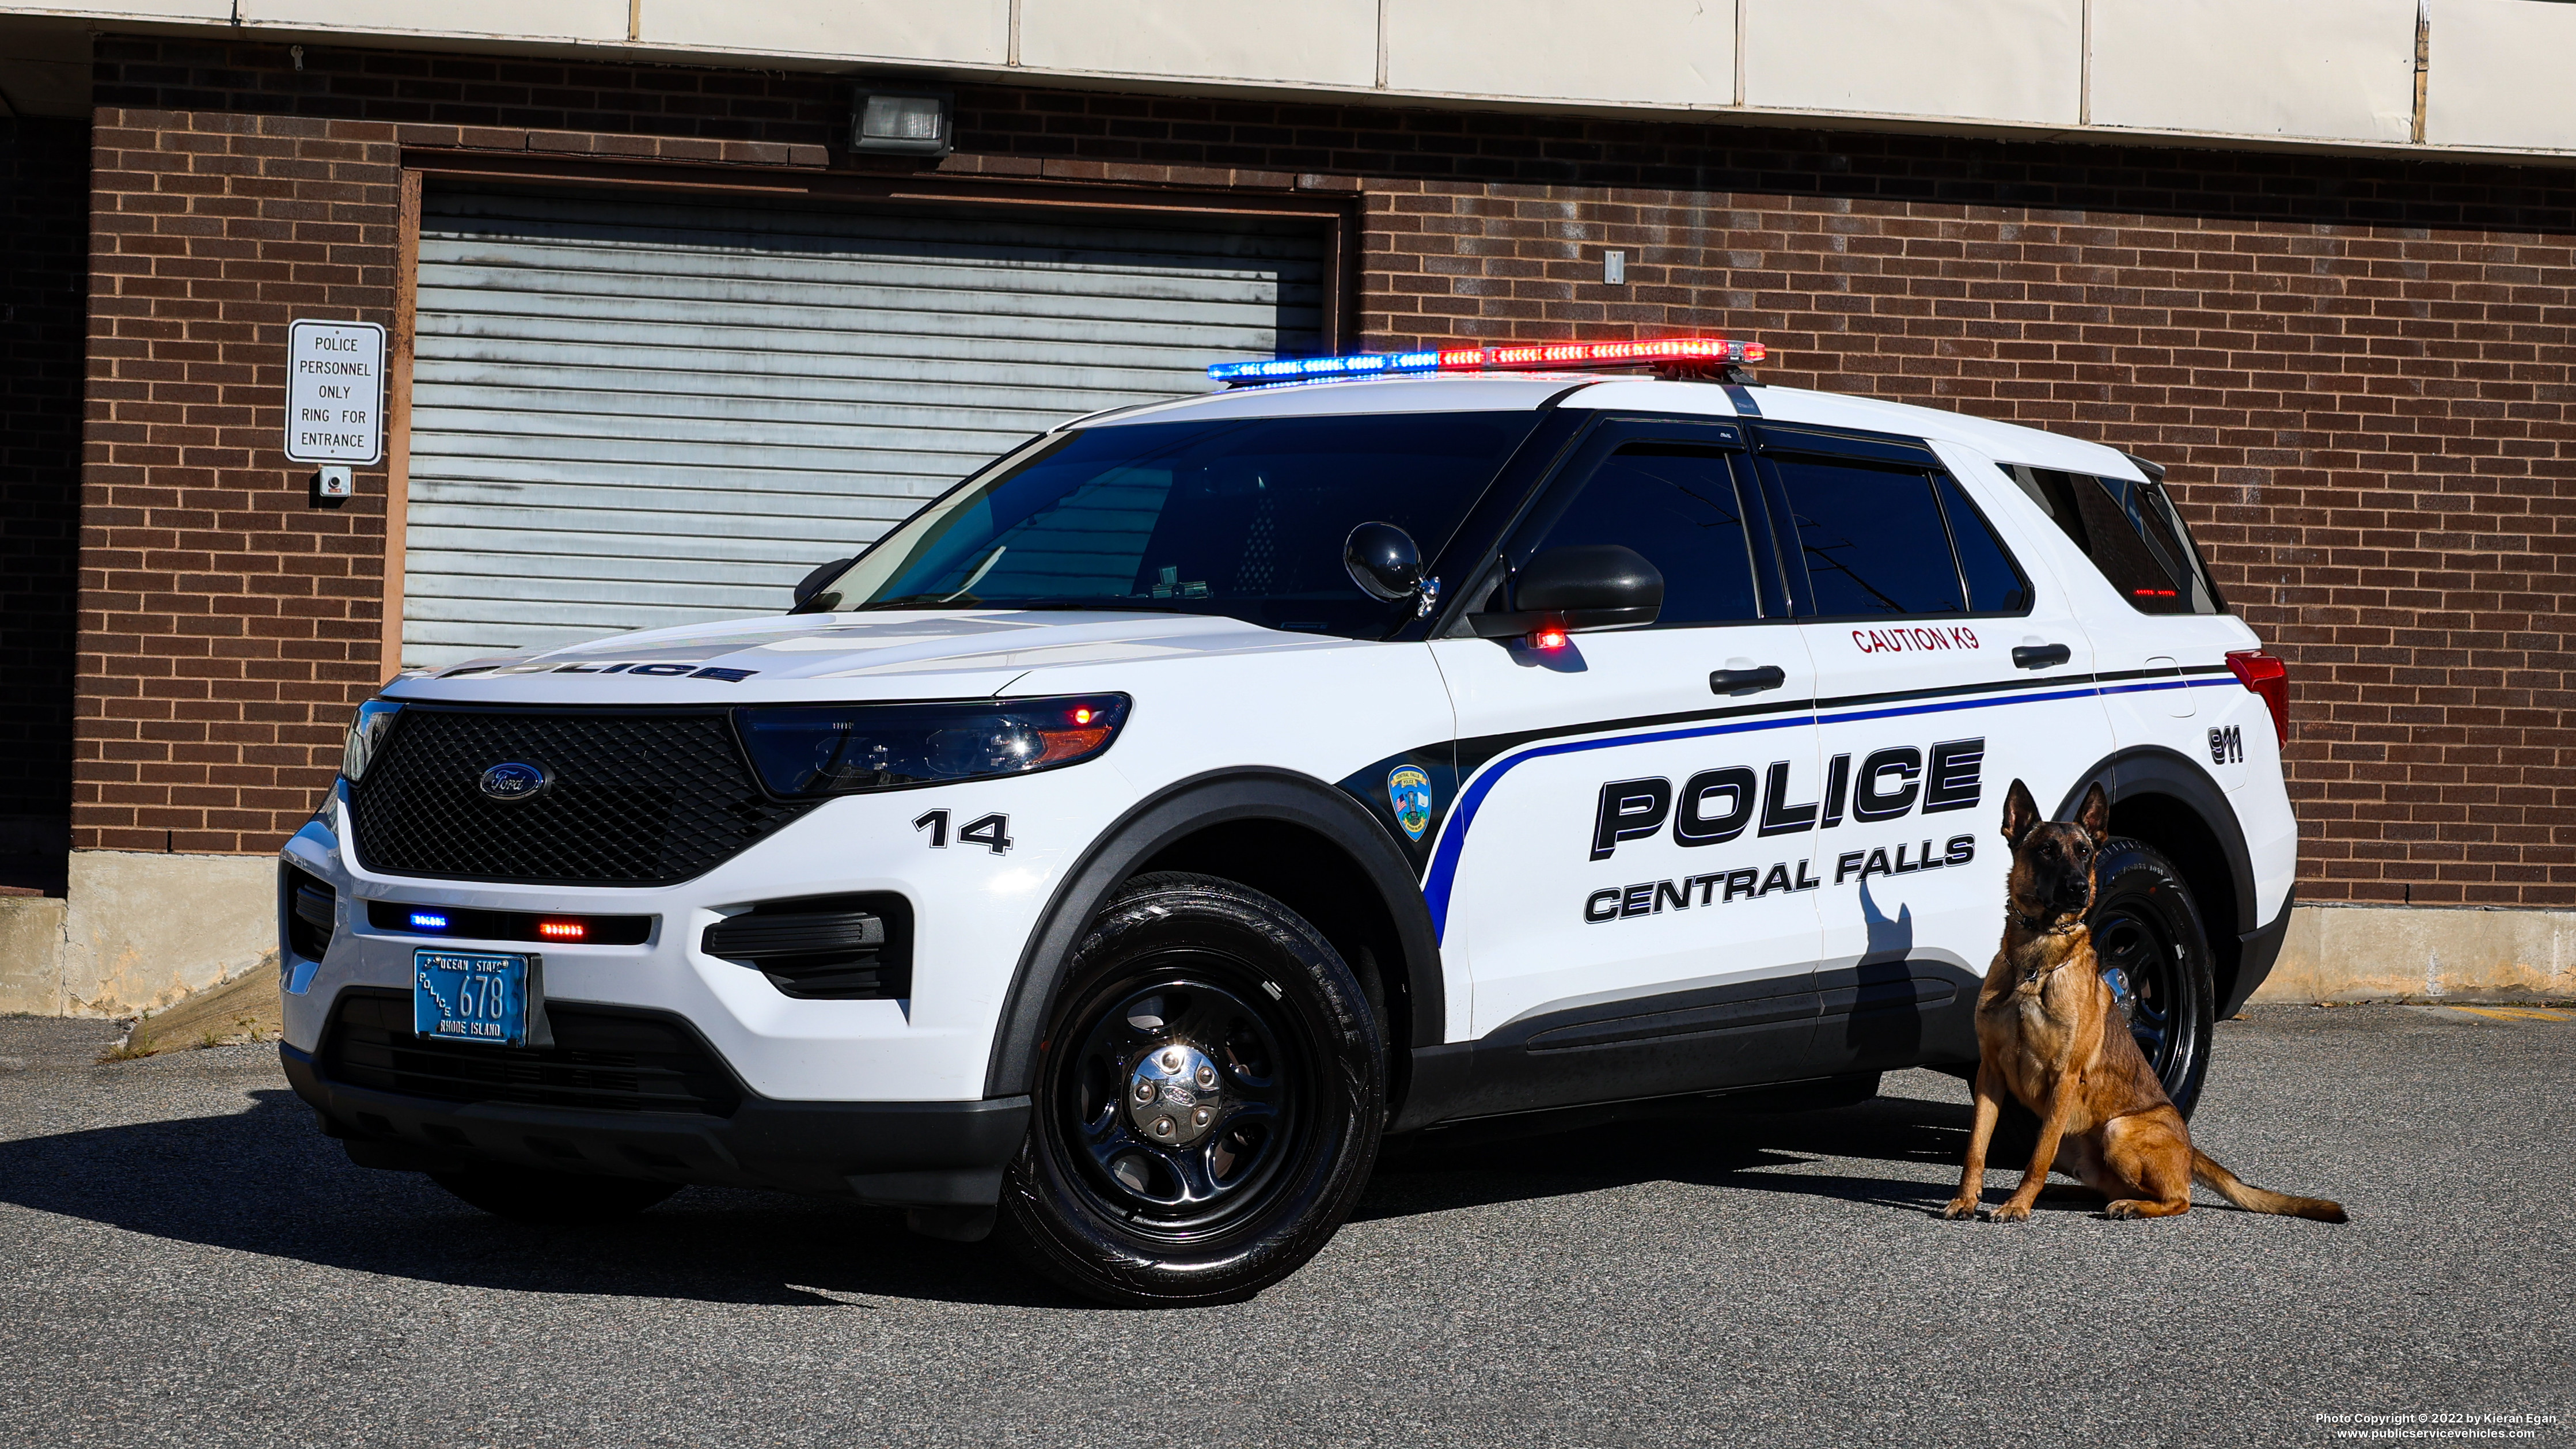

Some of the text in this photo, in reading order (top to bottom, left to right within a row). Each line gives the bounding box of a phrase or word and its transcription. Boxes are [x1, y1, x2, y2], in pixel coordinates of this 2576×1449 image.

[315, 337, 358, 352] POLICE
[299, 361, 371, 377] PERSONNEL
[318, 385, 351, 399] ONLY
[302, 408, 366, 424] RING FOR
[301, 433, 365, 447] ENTRANCE
[1852, 627, 1979, 654] CAUTION K9
[434, 663, 762, 683] POLICE
[2207, 724, 2244, 765] 911
[491, 770, 526, 790] Ford
[1589, 736, 1986, 862] POLICE
[911, 808, 1014, 857] 14
[1583, 833, 1976, 925] CENTRAL FALLS
[440, 958, 469, 971] OCEAN
[419, 972, 452, 1017] POLICE
[460, 975, 503, 1019] 678
[440, 1019, 501, 1037] RHODE ISLAND
